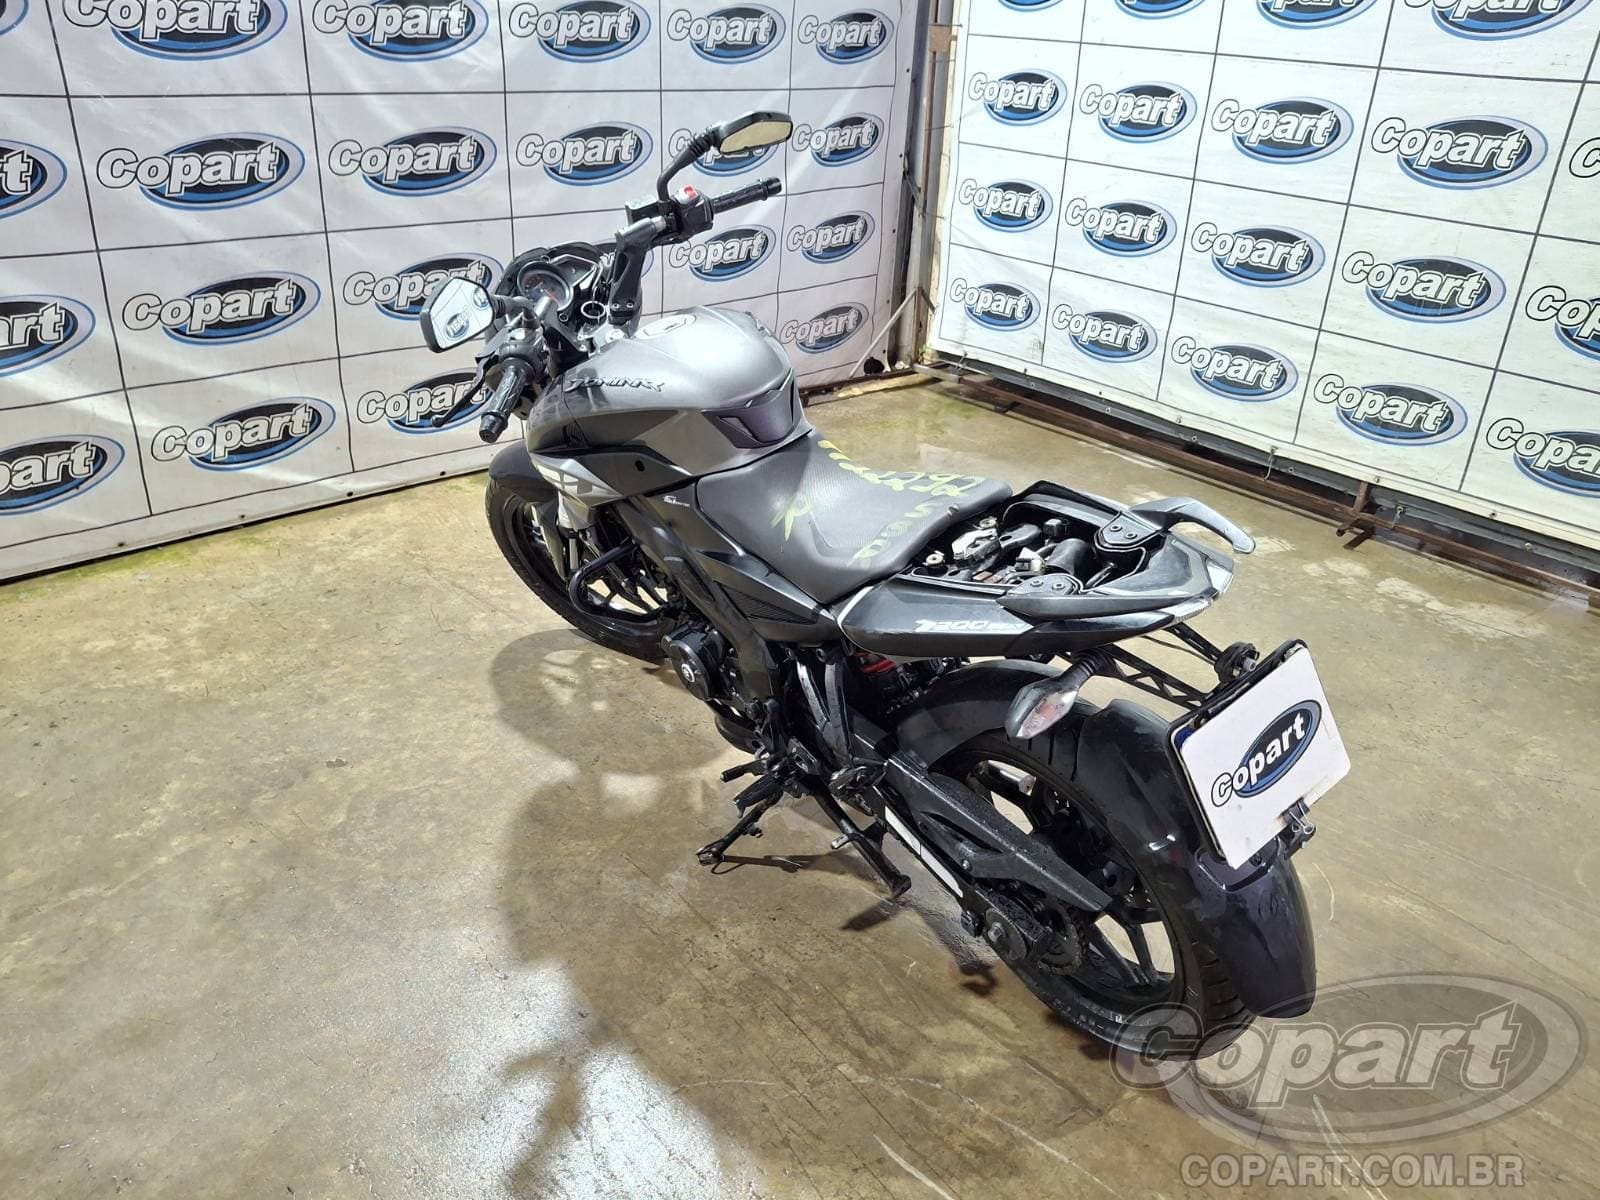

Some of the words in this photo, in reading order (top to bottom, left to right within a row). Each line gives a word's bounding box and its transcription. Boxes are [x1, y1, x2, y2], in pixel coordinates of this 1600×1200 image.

[63, 0, 260, 41] Copart
[312, 0, 467, 45] Copart
[509, 3, 635, 48] Copart
[667, 10, 779, 48] Copart
[799, 15, 883, 55] Copart
[968, 72, 1057, 112] Copart
[1080, 84, 1183, 127] Copart
[792, 119, 878, 160] Copart
[1211, 99, 1337, 147] Copart
[1371, 117, 1526, 170] Copart
[97, 141, 280, 196] Copart
[329, 135, 477, 184] Copart
[516, 129, 637, 174] Copart
[959, 178, 1042, 220] Copart
[1065, 198, 1164, 243] Copart
[670, 230, 766, 273] Copart
[787, 219, 866, 255] Copart
[1191, 223, 1309, 272] Copart
[950, 278, 1029, 321] Copart
[1341, 251, 1487, 307] Copart
[122, 278, 297, 332] Copart
[780, 310, 861, 345] Copart
[1052, 304, 1146, 352] Copart
[1171, 336, 1283, 389] Copart
[1314, 374, 1450, 433] Copart
[151, 402, 312, 463] Copart
[1211, 711, 1307, 807] Copart
